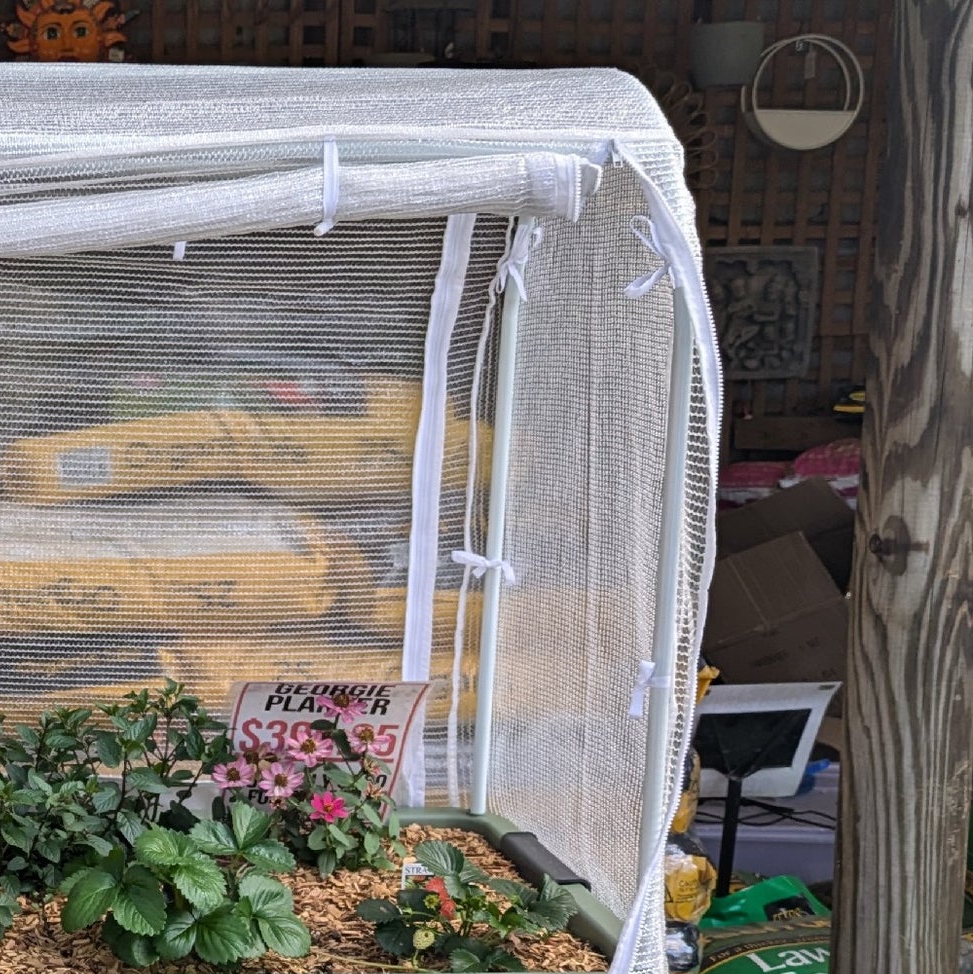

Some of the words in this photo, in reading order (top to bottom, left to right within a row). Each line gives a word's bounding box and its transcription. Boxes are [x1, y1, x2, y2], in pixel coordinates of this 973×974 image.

[275, 684, 396, 697] GEORGIE
[265, 695, 391, 715] PLAER
[746, 947, 830, 973] Law
